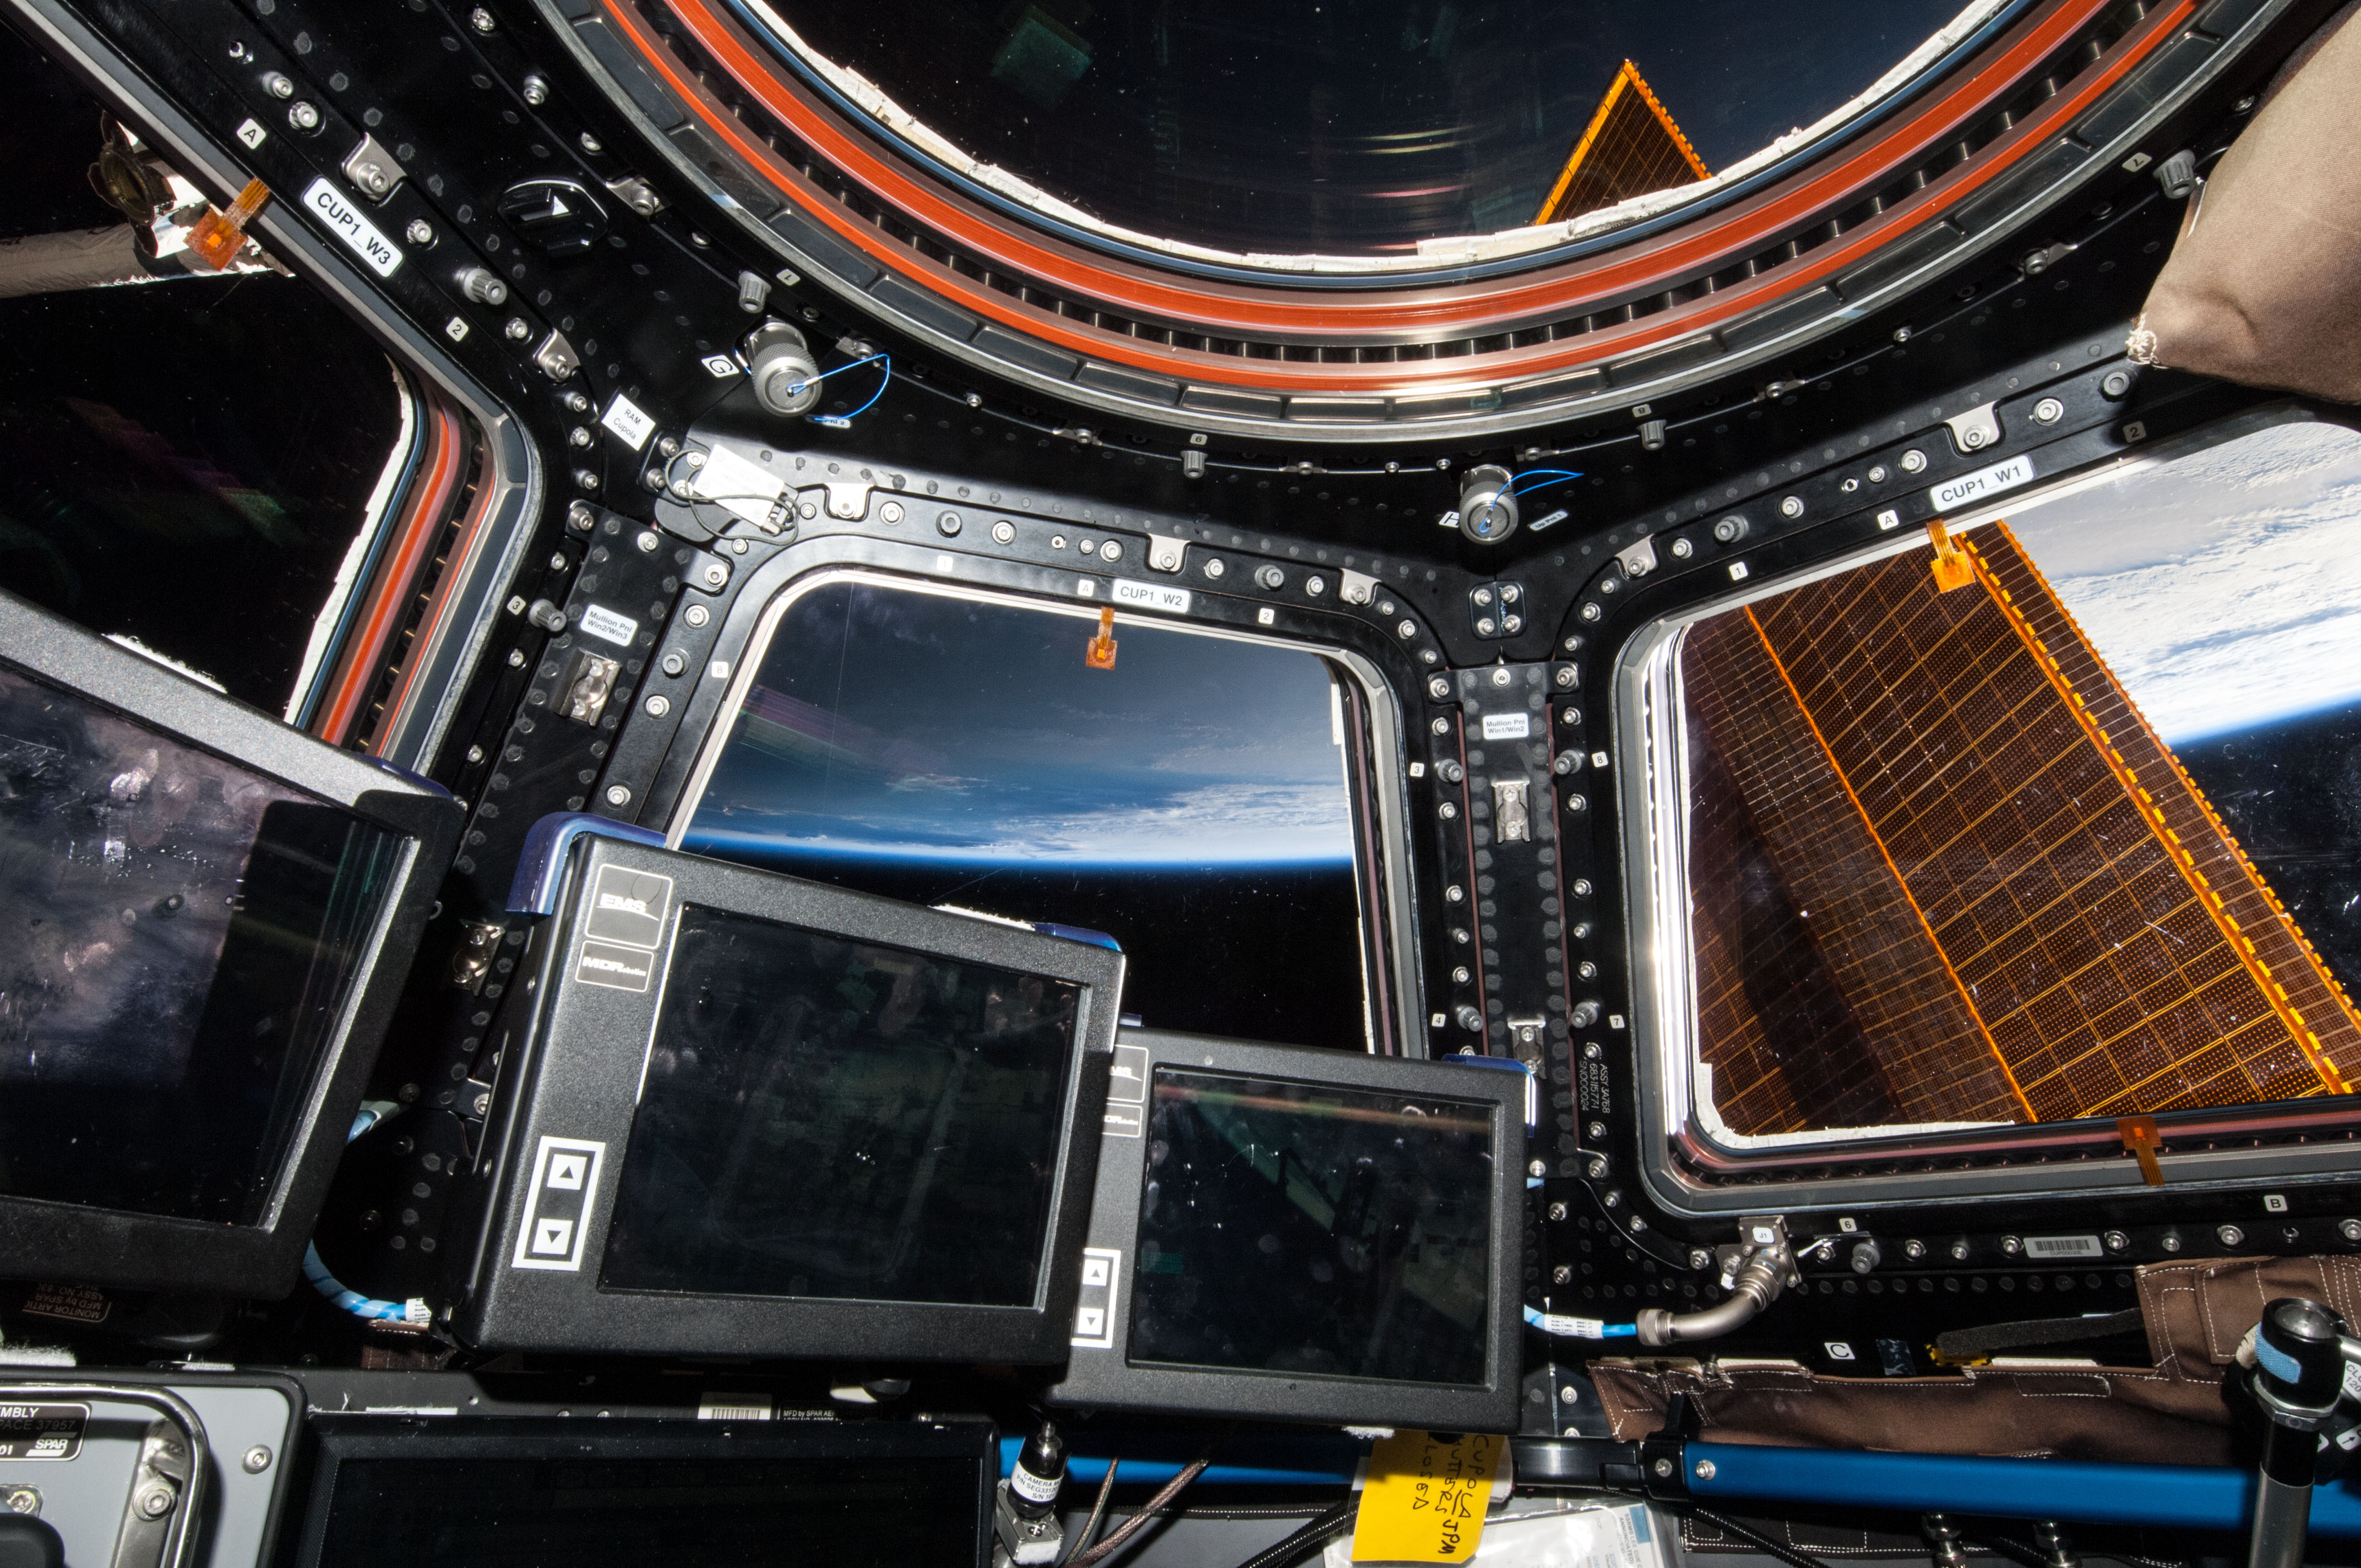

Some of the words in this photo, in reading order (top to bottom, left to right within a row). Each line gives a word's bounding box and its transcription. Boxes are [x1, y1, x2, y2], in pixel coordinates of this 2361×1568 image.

[244, 129, 257, 142] A
[318, 193, 390, 265] CUP1_W3
[453, 325, 462, 335] 2
[709, 359, 733, 374] G
[624, 409, 640, 426] RAM
[613, 417, 637, 440] Cupola
[2130, 427, 2139, 437] 2
[1941, 465, 2021, 502] CUP1_W1
[1885, 516, 1893, 525] A
[1120, 586, 1182, 606] CUP1_W2
[513, 601, 521, 610] 3
[589, 611, 618, 628] Mullion
[619, 623, 633, 633] Pnl
[1264, 612, 1270, 620] 2
[587, 618, 628, 640] Win2/Win3
[716, 666, 723, 675] 8
[600, 892, 647, 913] EMS
[1435, 1016, 1441, 1025] 4
[1111, 1065, 1132, 1077] MS
[1600, 1063, 1609, 1086] ASSY
[1579, 1060, 1589, 1110] SN000024
[1601, 1086, 1611, 1113] 3A768
[2270, 1199, 2281, 1208] B
[1845, 1221, 1852, 1229] 6
[35, 1294, 63, 1303] SPAR
[66, 1296, 78, 1304] by
[80, 1300, 102, 1310] MFD
[55, 1304, 100, 1319] MONITOR
[1830, 1343, 1849, 1358] C
[0, 1407, 39, 1418] MBLY
[798, 1410, 806, 1418] by
[36, 1420, 75, 1430] 37957
[35, 1439, 68, 1449] SPAR
[1016, 1474, 1025, 1485] P/N
[1024, 1473, 1052, 1487] CAMERA
[1459, 1434, 1489, 1518] CUPOLA
[1438, 1519, 1461, 1554] JPM
[1619, 1517, 1634, 1564] ANNUNCIATED)
